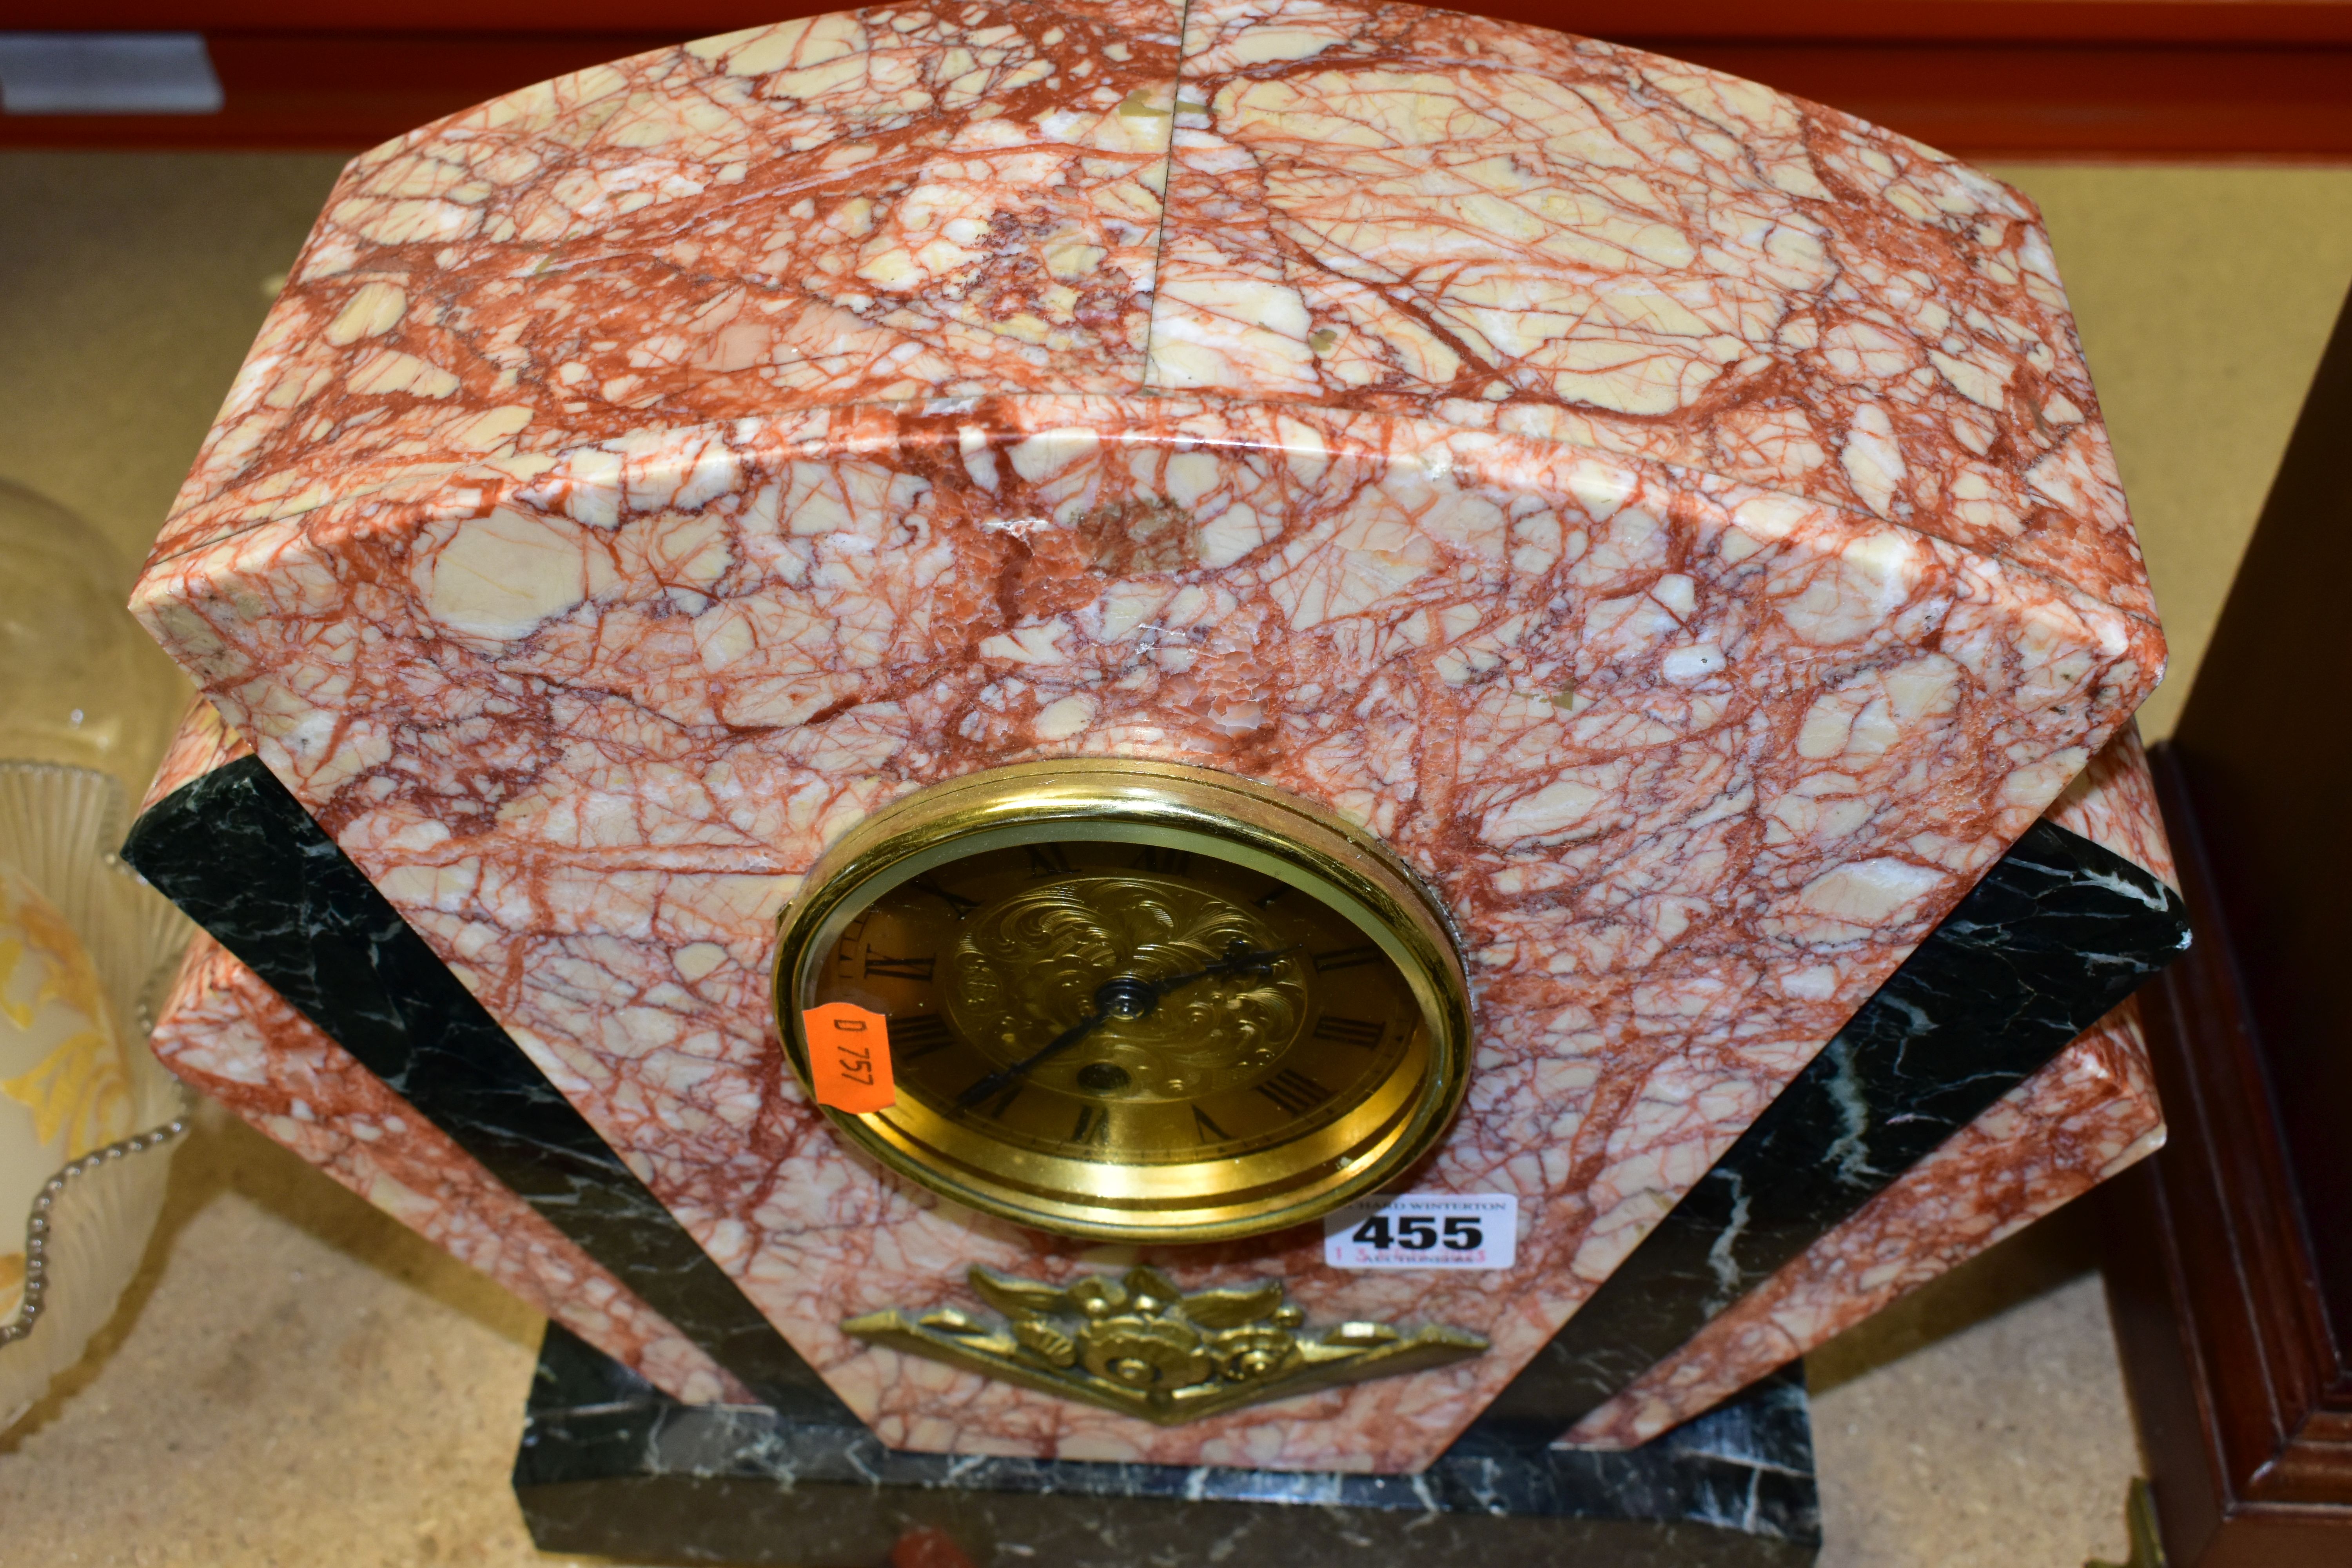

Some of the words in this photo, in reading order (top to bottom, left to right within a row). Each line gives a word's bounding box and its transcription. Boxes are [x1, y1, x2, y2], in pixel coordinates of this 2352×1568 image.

[1309, 945, 1385, 978] II
[833, 1019, 868, 1031] D
[1313, 1016, 1386, 1051] III
[837, 1046, 874, 1085] 757
[1252, 1069, 1339, 1118] IIII
[1411, 1202, 1506, 1210] WINTERTON
[1353, 1216, 1483, 1250] 455
